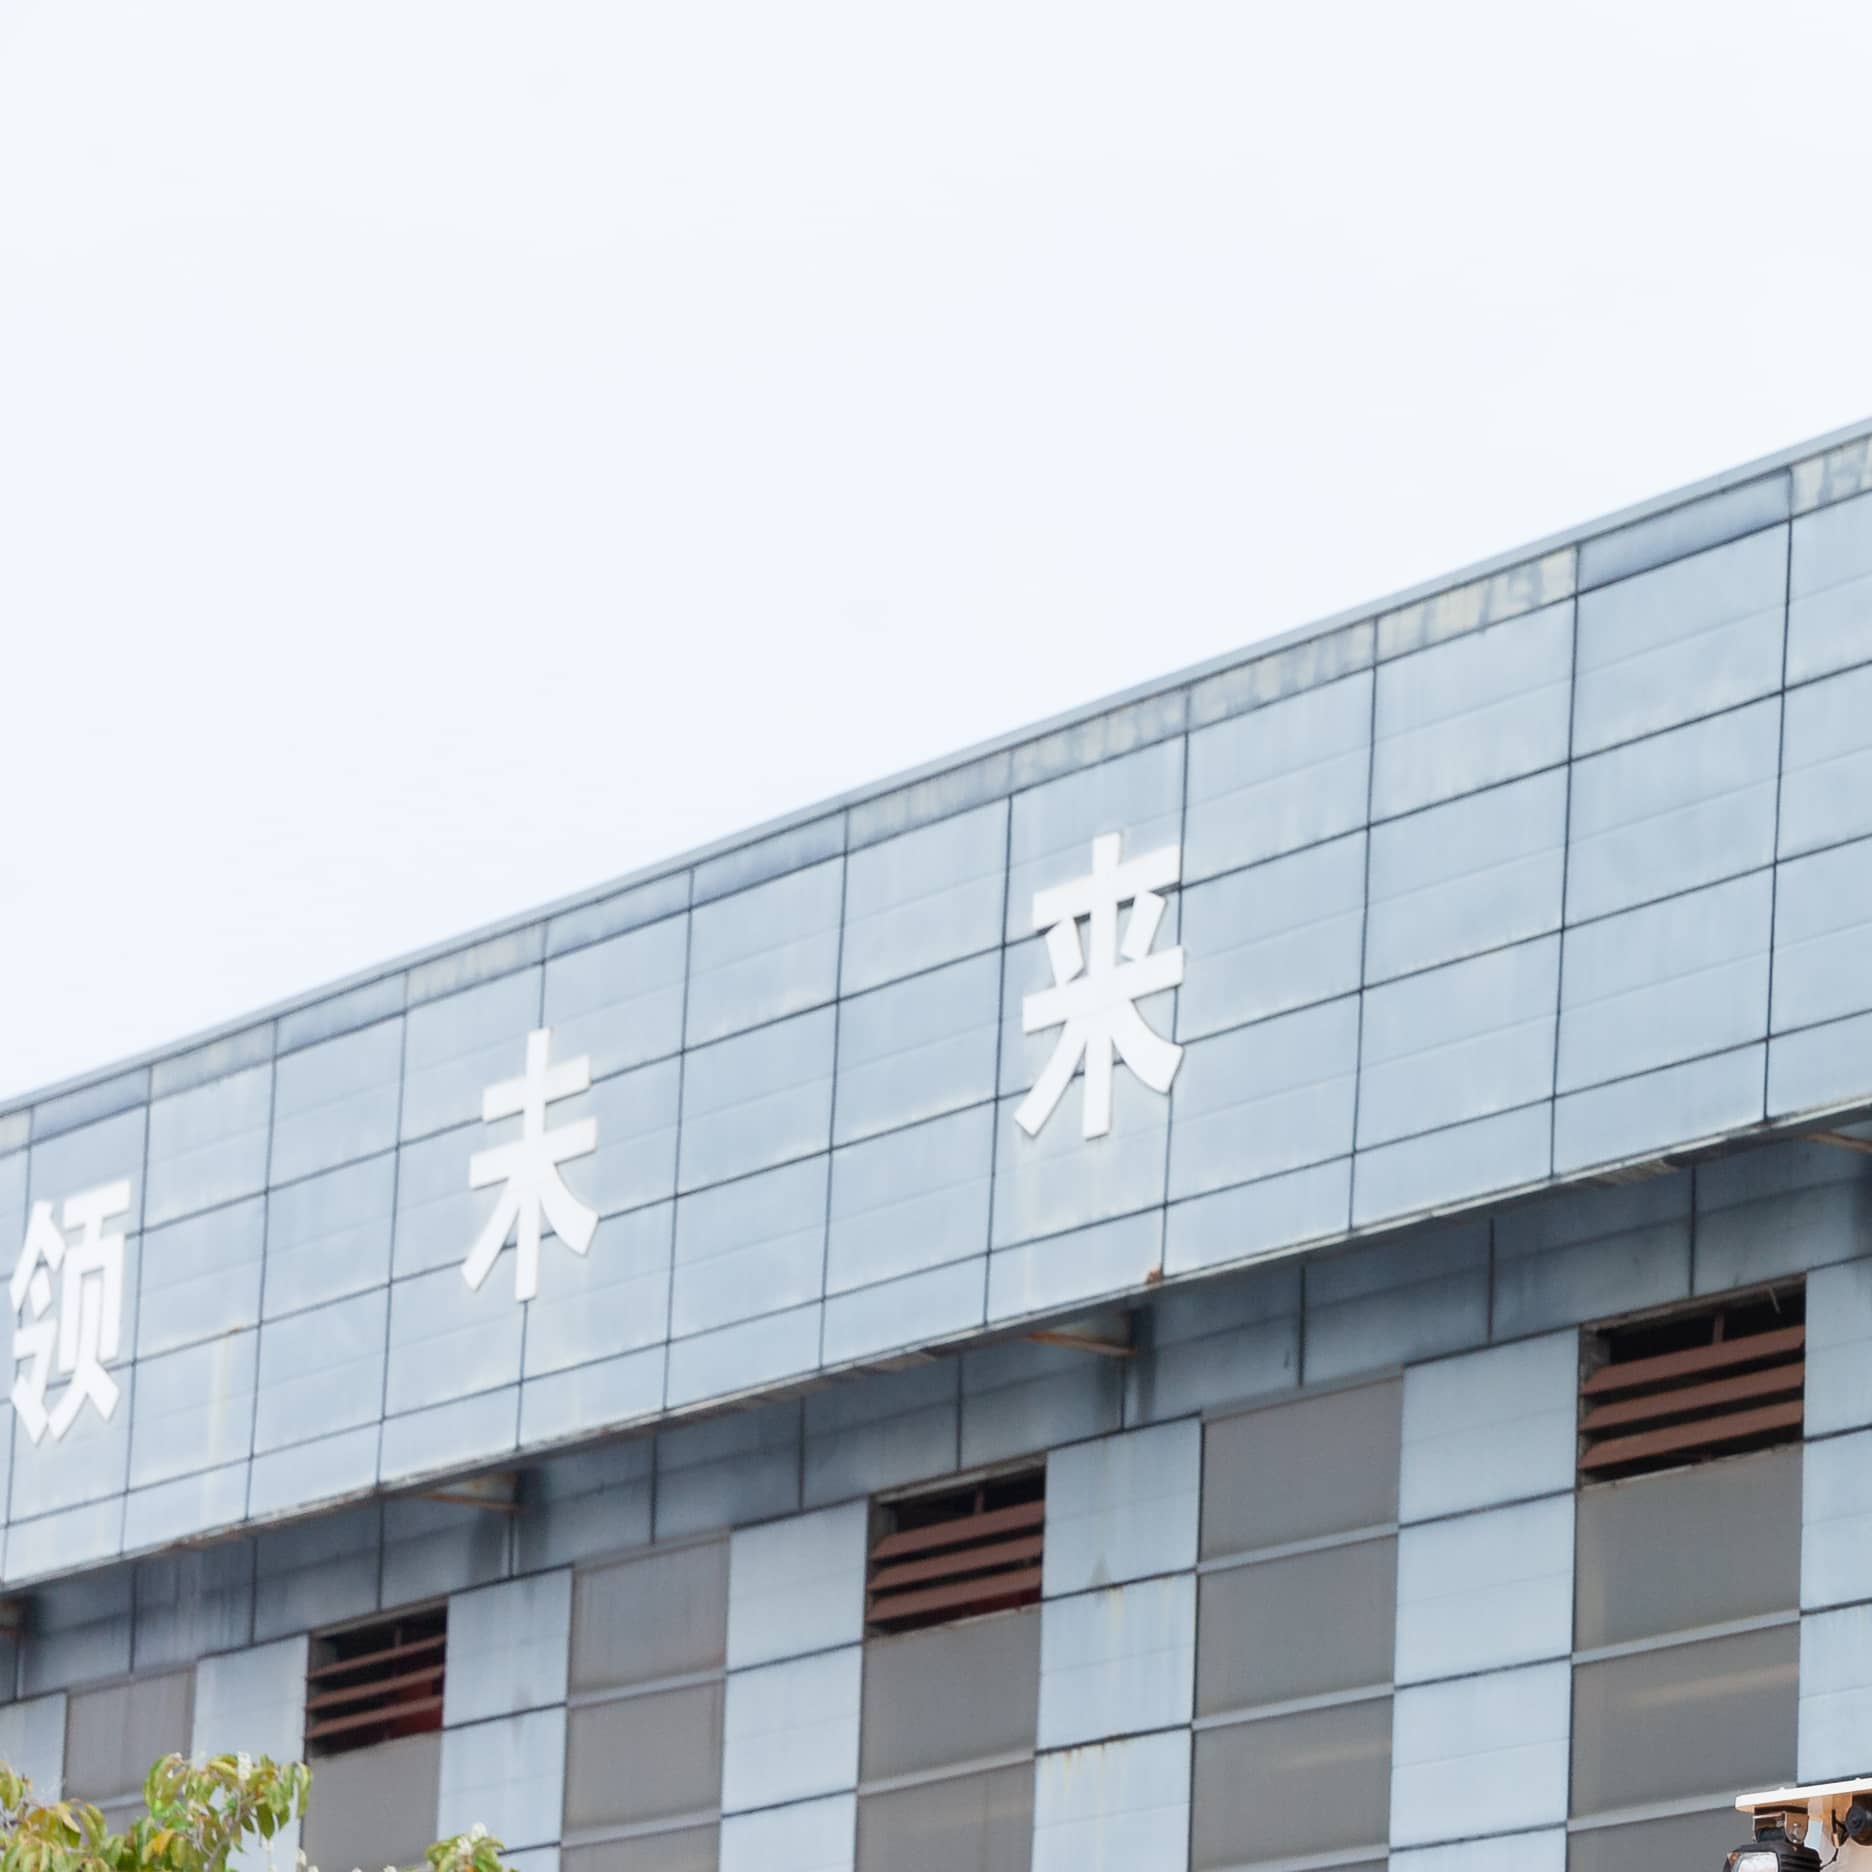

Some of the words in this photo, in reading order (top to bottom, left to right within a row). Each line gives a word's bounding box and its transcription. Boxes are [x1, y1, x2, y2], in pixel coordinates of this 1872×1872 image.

[10, 1178, 131, 1444] 领
[461, 1028, 598, 1302] 未
[1014, 833, 1183, 1138] 来
